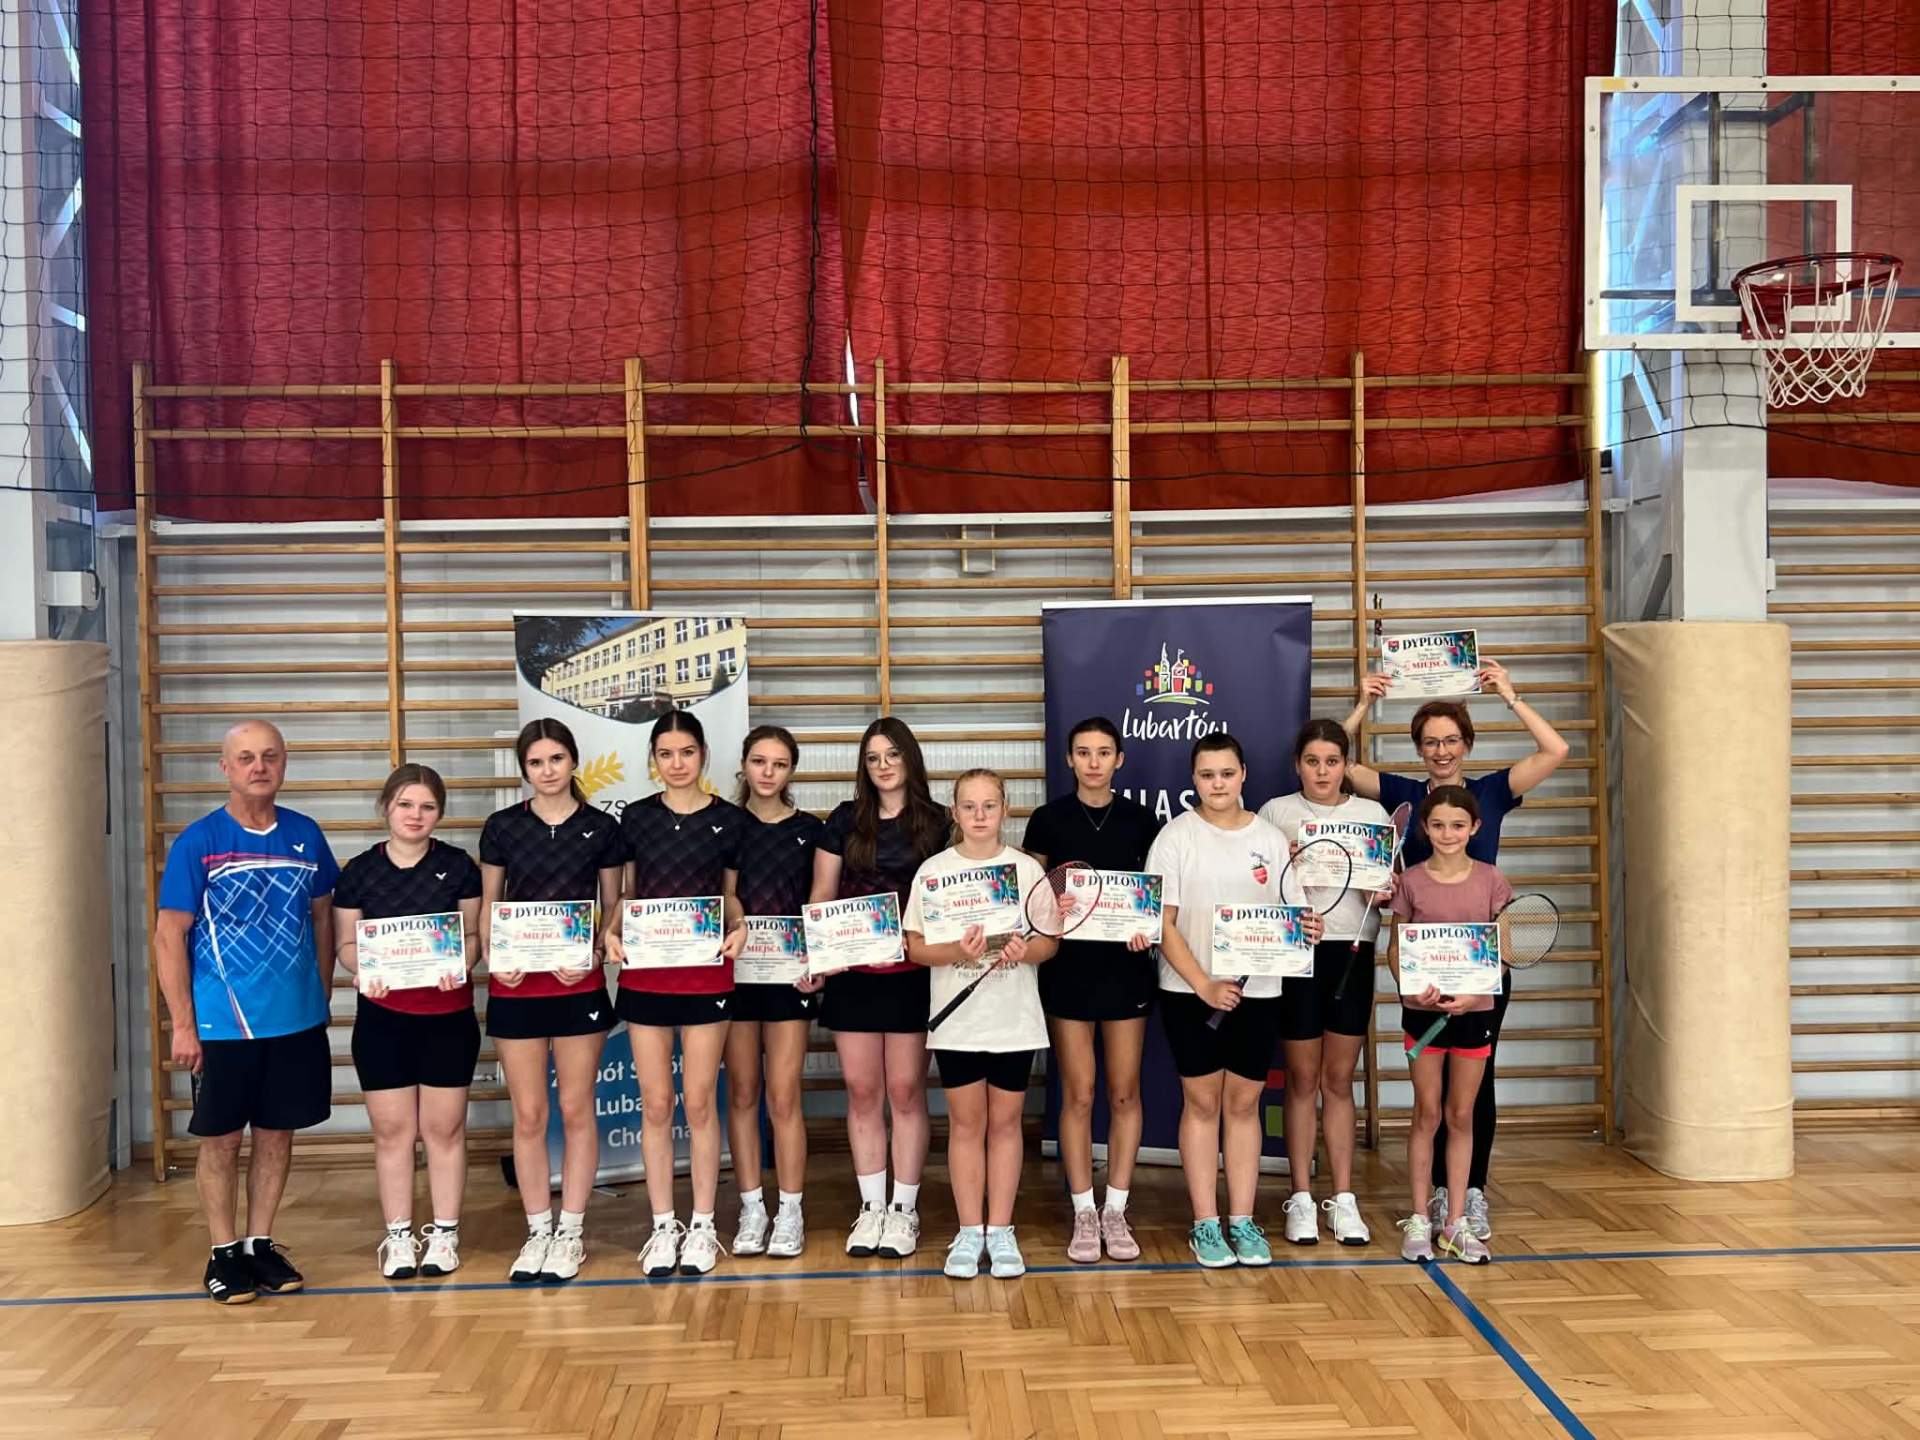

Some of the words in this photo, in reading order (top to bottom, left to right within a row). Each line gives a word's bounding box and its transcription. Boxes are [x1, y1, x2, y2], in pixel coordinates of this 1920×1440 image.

[1403, 636, 1455, 650] DYPLOM
[1122, 708, 1228, 741] Lubartów
[1320, 824, 1372, 839] DYPLOM
[942, 869, 995, 888] DYPLOM
[646, 902, 699, 915] DYPLOM
[952, 896, 990, 908] MIEJSCA
[515, 906, 570, 918] DYPLOM
[825, 901, 877, 918] DYPLOM
[1237, 909, 1290, 922] DYPLOM
[381, 920, 437, 935] DYPLOM
[748, 920, 788, 932] YPLOM
[1244, 934, 1282, 944] MIEJSCA
[1421, 928, 1475, 940] DYPLOM
